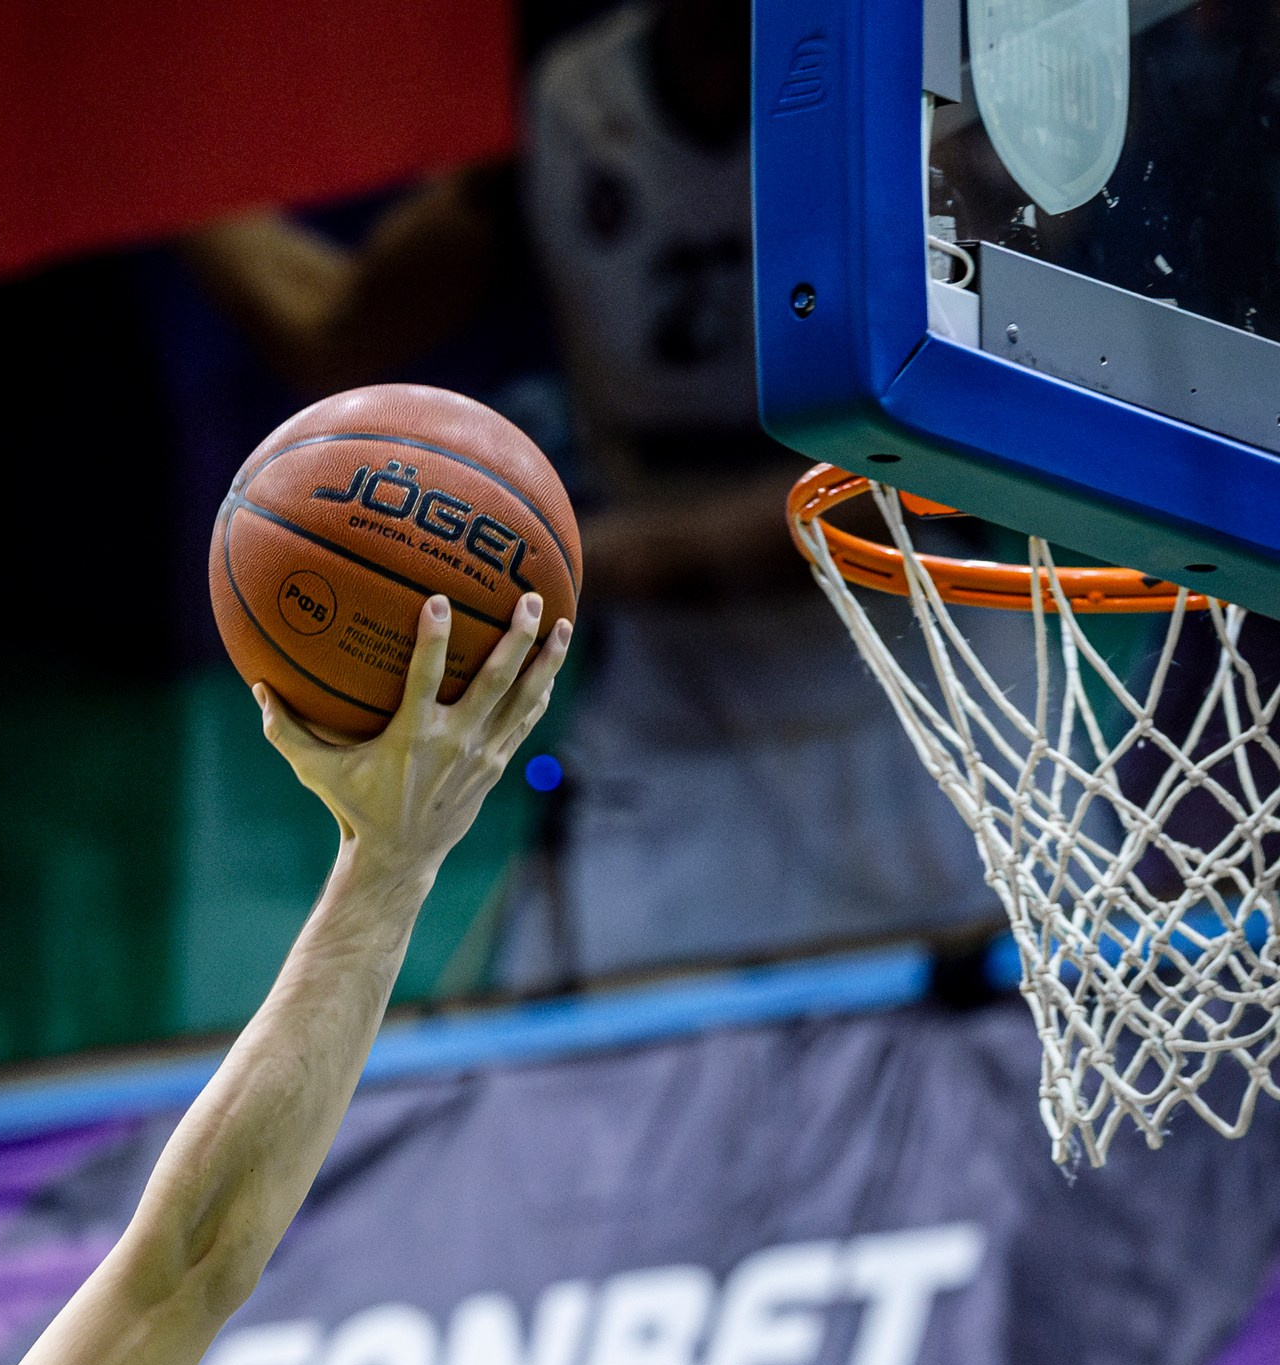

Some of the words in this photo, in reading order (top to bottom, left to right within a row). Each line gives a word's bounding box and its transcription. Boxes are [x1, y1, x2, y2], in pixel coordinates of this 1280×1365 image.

[311, 460, 535, 593] JÖGEL
[348, 514, 416, 549] OFFICIAL
[419, 540, 462, 571] GAME
[462, 563, 497, 594] BALL
[283, 582, 329, 624] РФБ
